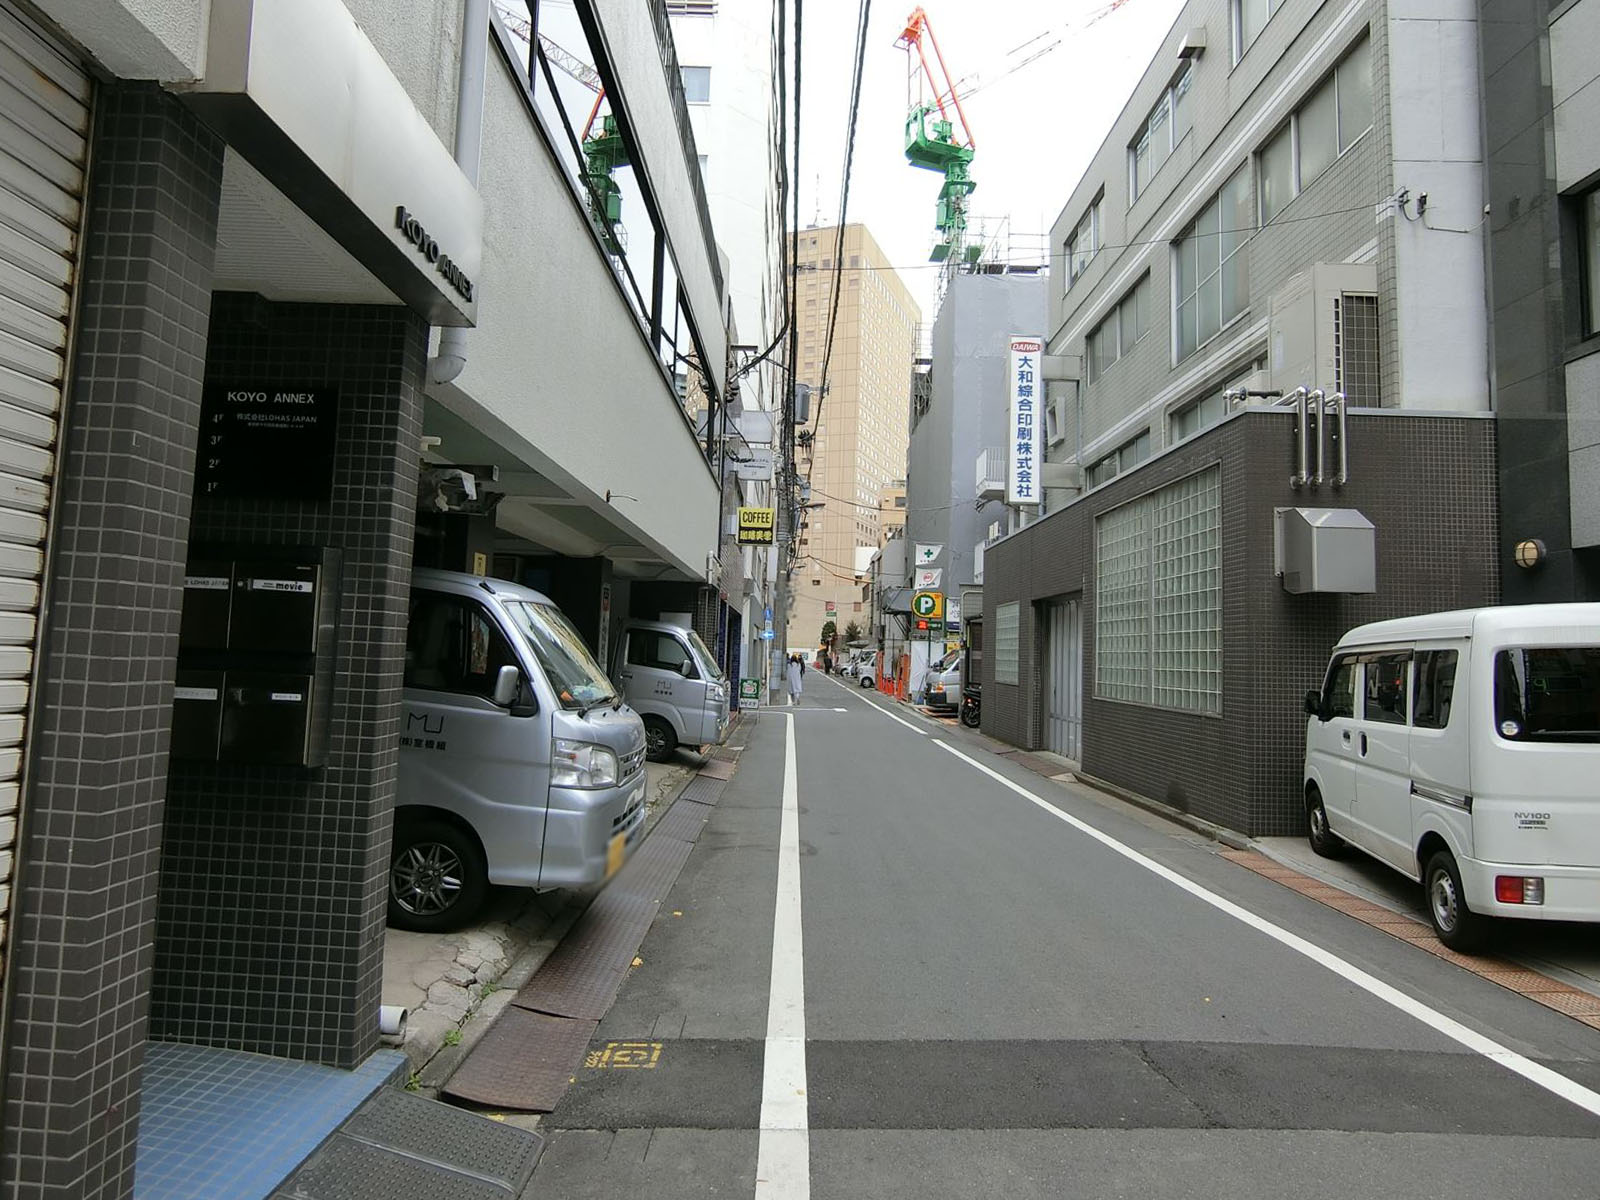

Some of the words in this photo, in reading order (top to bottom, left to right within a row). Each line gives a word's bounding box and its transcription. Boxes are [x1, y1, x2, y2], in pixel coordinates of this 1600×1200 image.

[395, 206, 440, 263] KOYO
[436, 255, 474, 302] ANNEX
[1012, 342, 1039, 351] DAIWA
[227, 391, 267, 403] KOYO
[274, 392, 315, 404] ANNEX
[212, 413, 224, 424] 4F
[292, 415, 317, 424] JAPAN
[1016, 355, 1033, 498] 大和綜合印刷株式会社
[210, 434, 222, 446] 3F
[208, 458, 220, 469] 2F
[207, 481, 219, 493] 1F
[742, 511, 771, 524] COFFEE
[276, 581, 303, 591] movie
[920, 597, 934, 613] P
[1514, 812, 1551, 820] NV100
